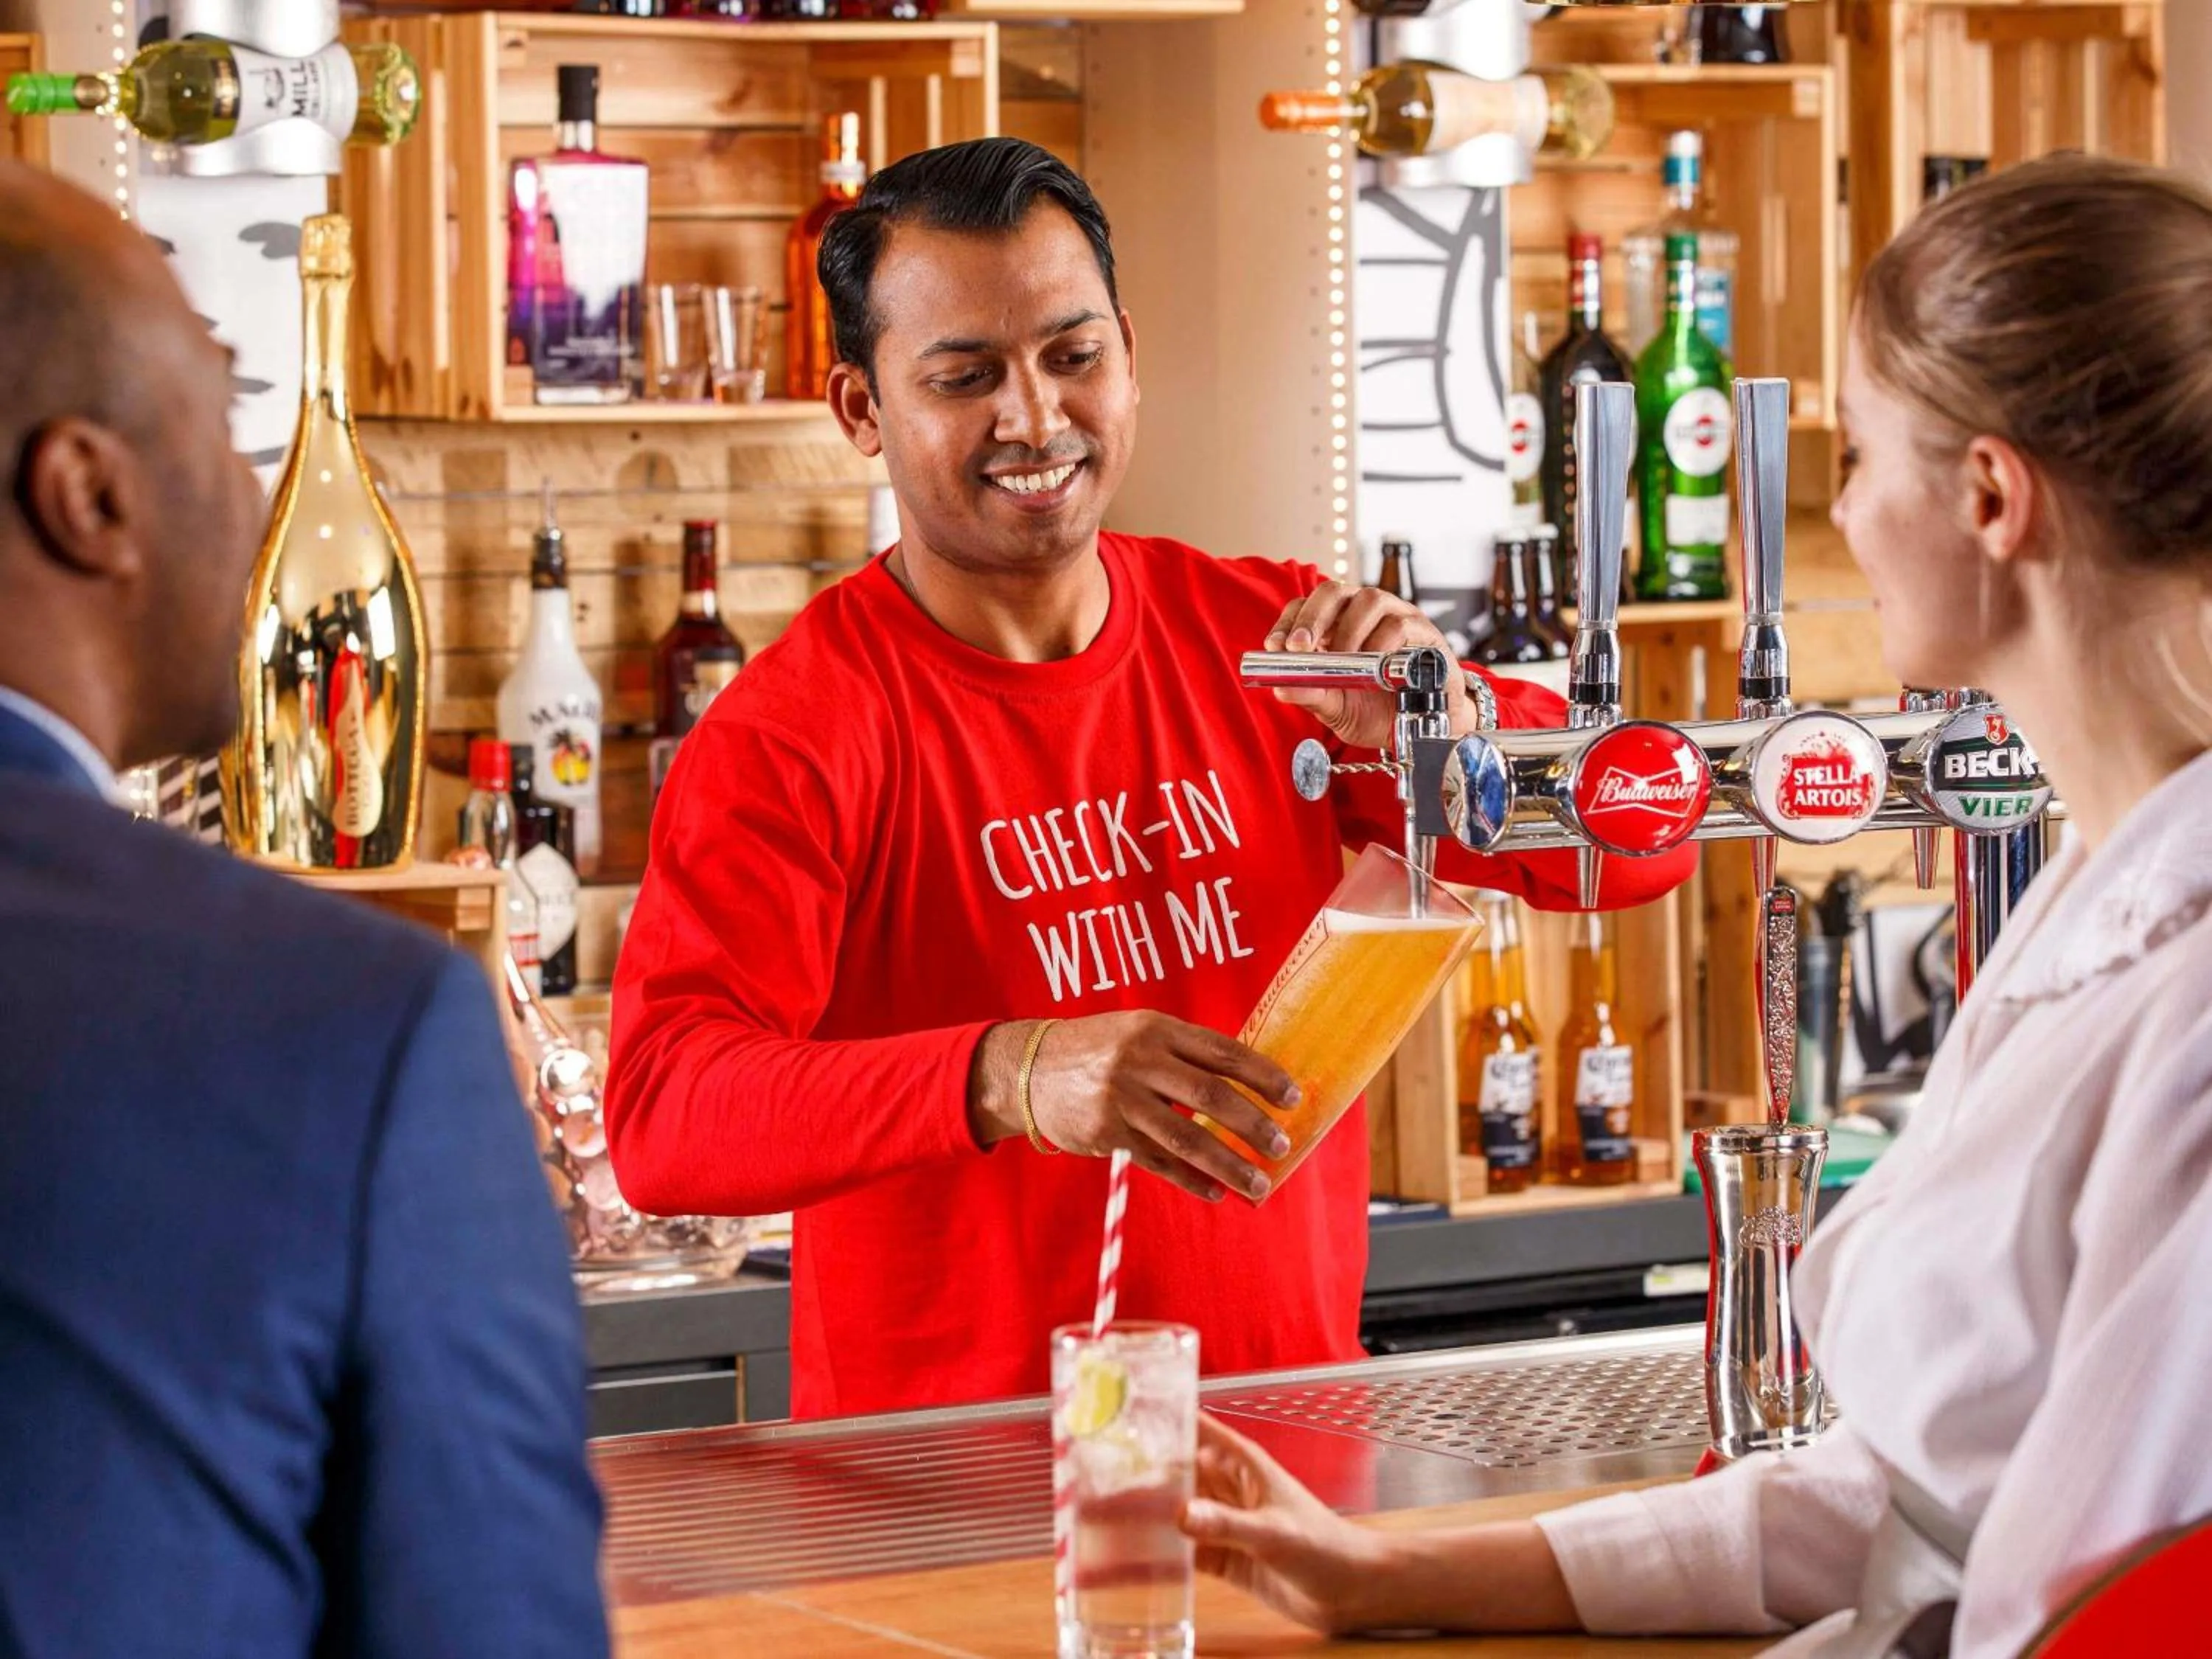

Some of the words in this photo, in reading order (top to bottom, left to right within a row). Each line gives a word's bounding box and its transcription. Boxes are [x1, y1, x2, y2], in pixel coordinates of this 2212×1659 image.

[291, 60, 308, 116] MILL
[1793, 764, 1862, 785] STELLA
[1944, 747, 2037, 779] BECK
[1596, 776, 1697, 804] Budweiser
[1794, 788, 1863, 807] ARTOIS
[1958, 796, 2033, 816] VIER
[980, 769, 1240, 900] CHECK-IN
[1026, 900, 1164, 1002] WITH
[1164, 876, 1254, 970] ME
